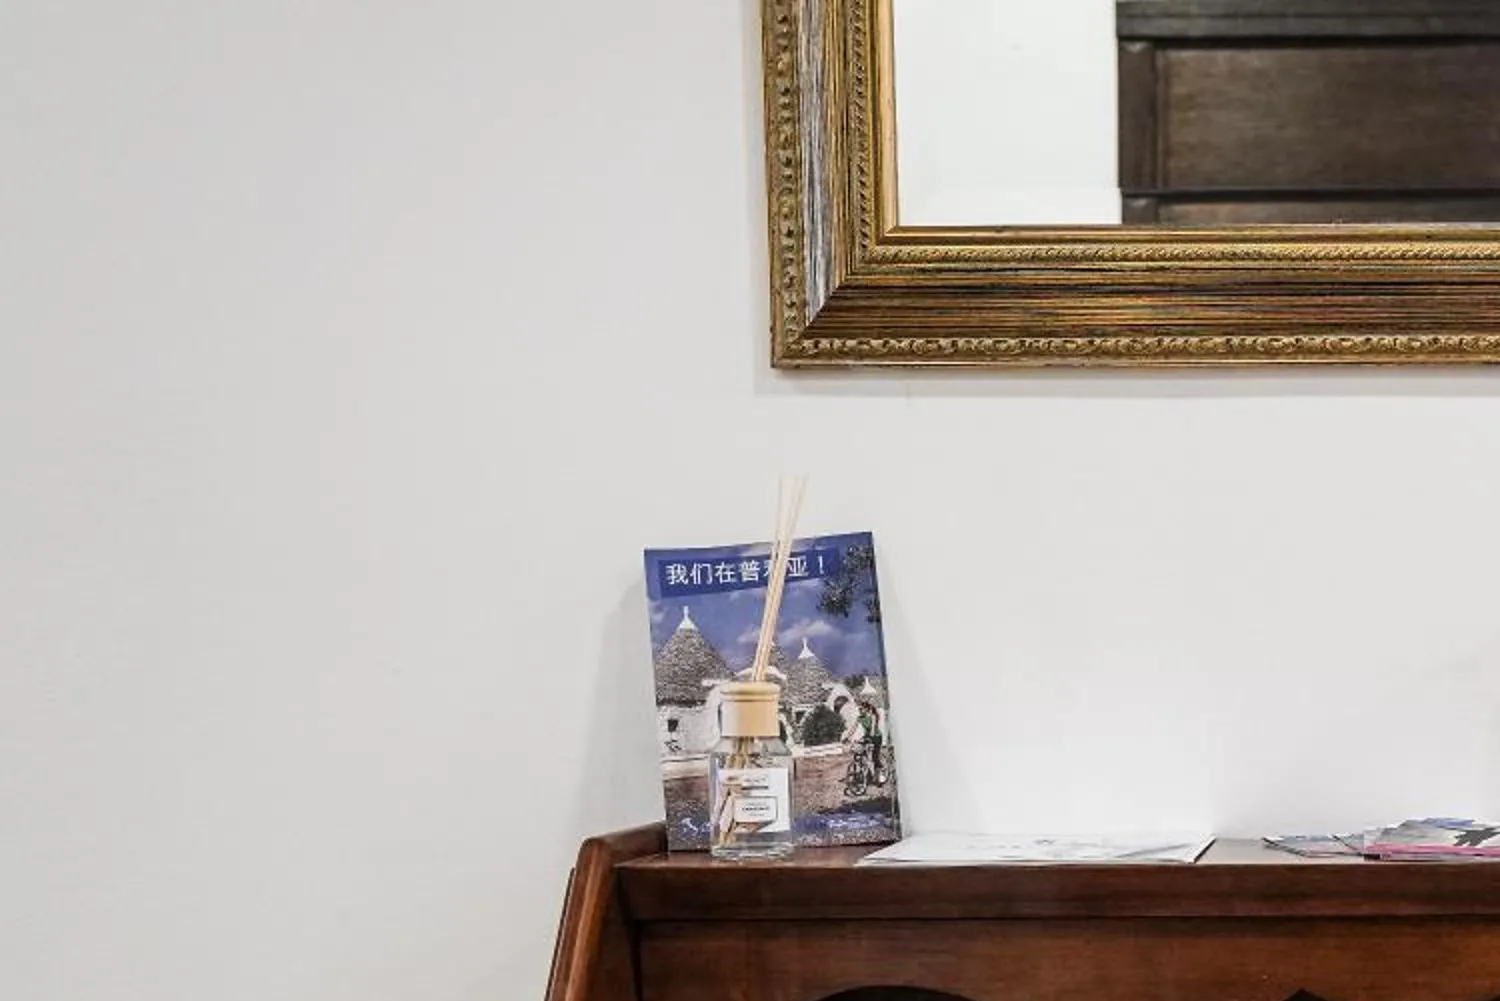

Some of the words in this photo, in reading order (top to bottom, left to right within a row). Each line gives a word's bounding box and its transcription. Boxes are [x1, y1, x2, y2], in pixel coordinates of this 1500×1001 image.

[666, 556, 824, 585] 我们在普亚！
